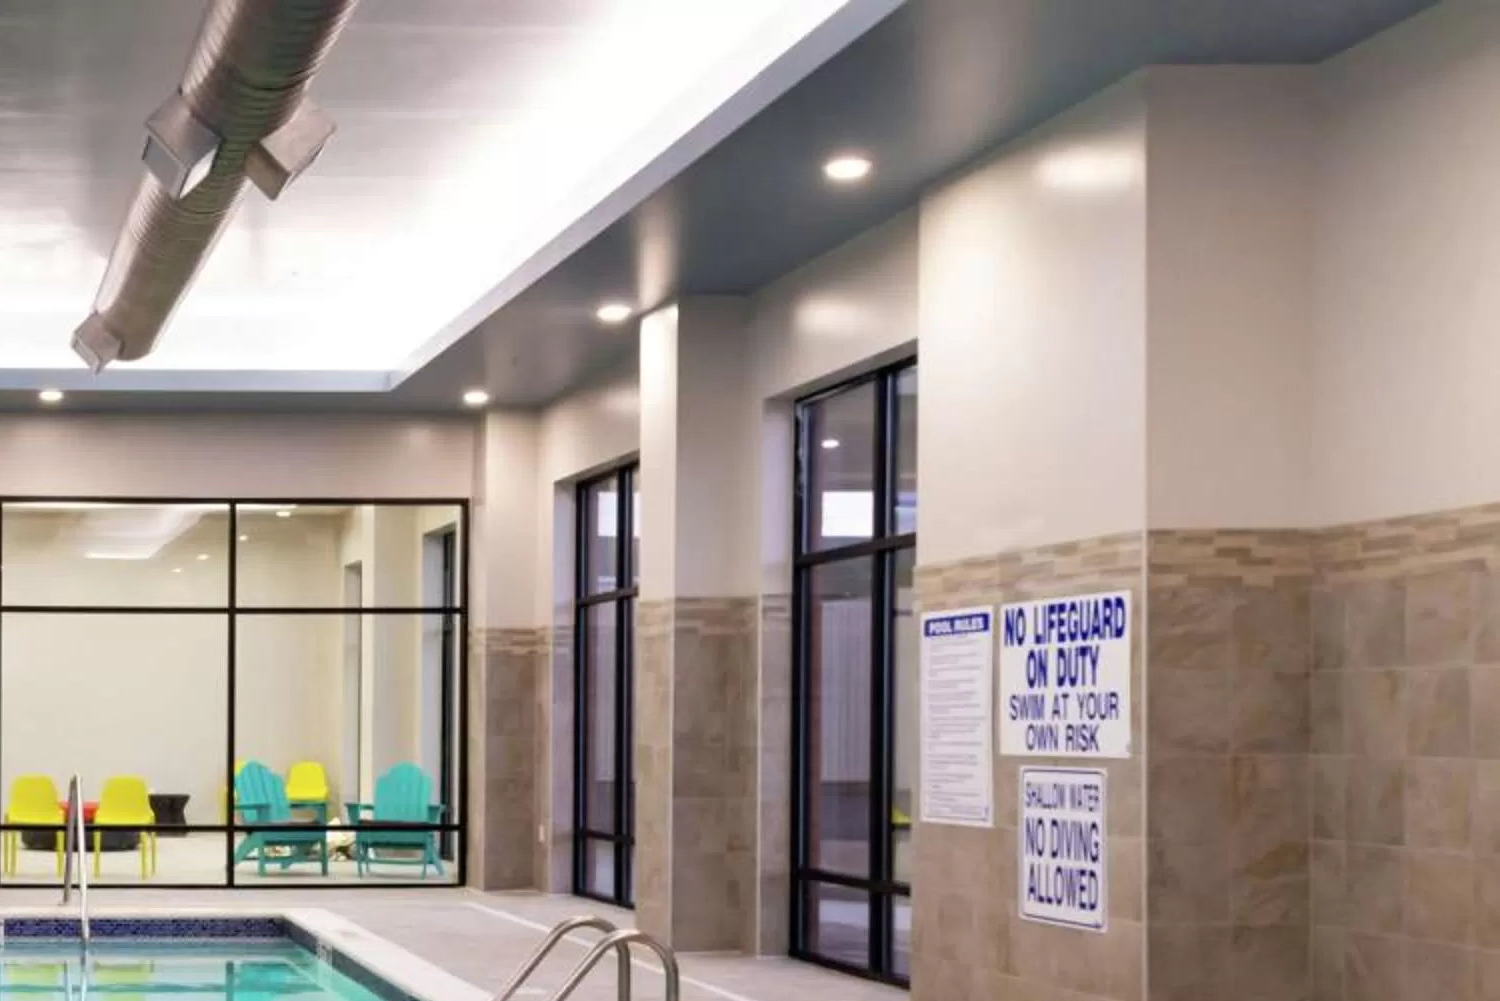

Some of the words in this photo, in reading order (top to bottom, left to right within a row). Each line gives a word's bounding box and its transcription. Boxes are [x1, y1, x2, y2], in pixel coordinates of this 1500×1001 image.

[1004, 606, 1026, 646] NO
[1035, 598, 1125, 643] LIFEGUARD
[1026, 651, 1048, 688] ON
[1057, 646, 1100, 687] DUTY
[1009, 694, 1045, 722] SWIM
[1051, 693, 1068, 720] AT
[1077, 692, 1119, 721] YOUR
[1026, 725, 1059, 750] OWN
[1065, 724, 1100, 752] RISK
[1025, 818, 1045, 857] NO
[1051, 819, 1099, 862] DIVING
[1027, 863, 1098, 910] ALLOWED
